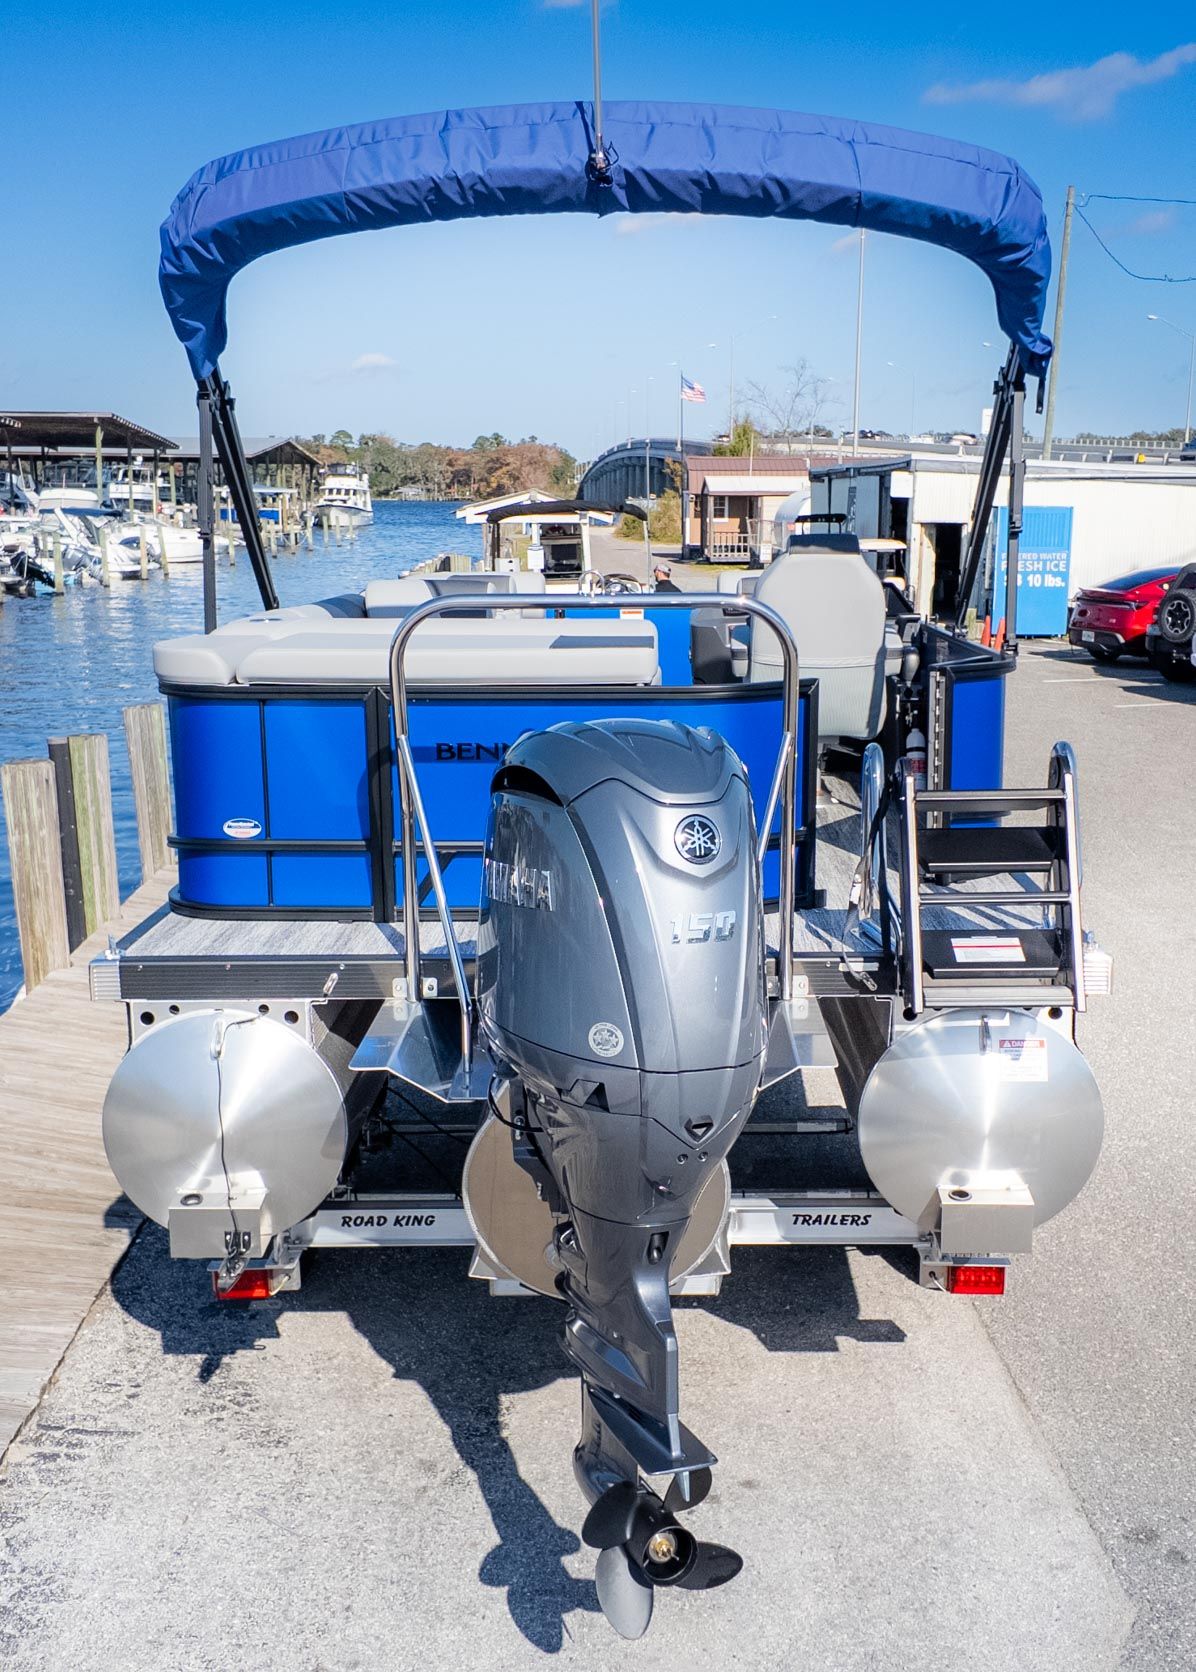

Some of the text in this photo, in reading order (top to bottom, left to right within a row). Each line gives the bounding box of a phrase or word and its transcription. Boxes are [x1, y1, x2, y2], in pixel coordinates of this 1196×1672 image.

[1001, 552, 1067, 560] FERED WATER
[1001, 560, 1067, 572] FESH ICE
[1027, 573, 1042, 587] 10
[1044, 573, 1066, 587] lbs.
[670, 911, 737, 944] 150
[341, 1215, 436, 1228] ROAD KING
[792, 1214, 872, 1227] TRAILERS
